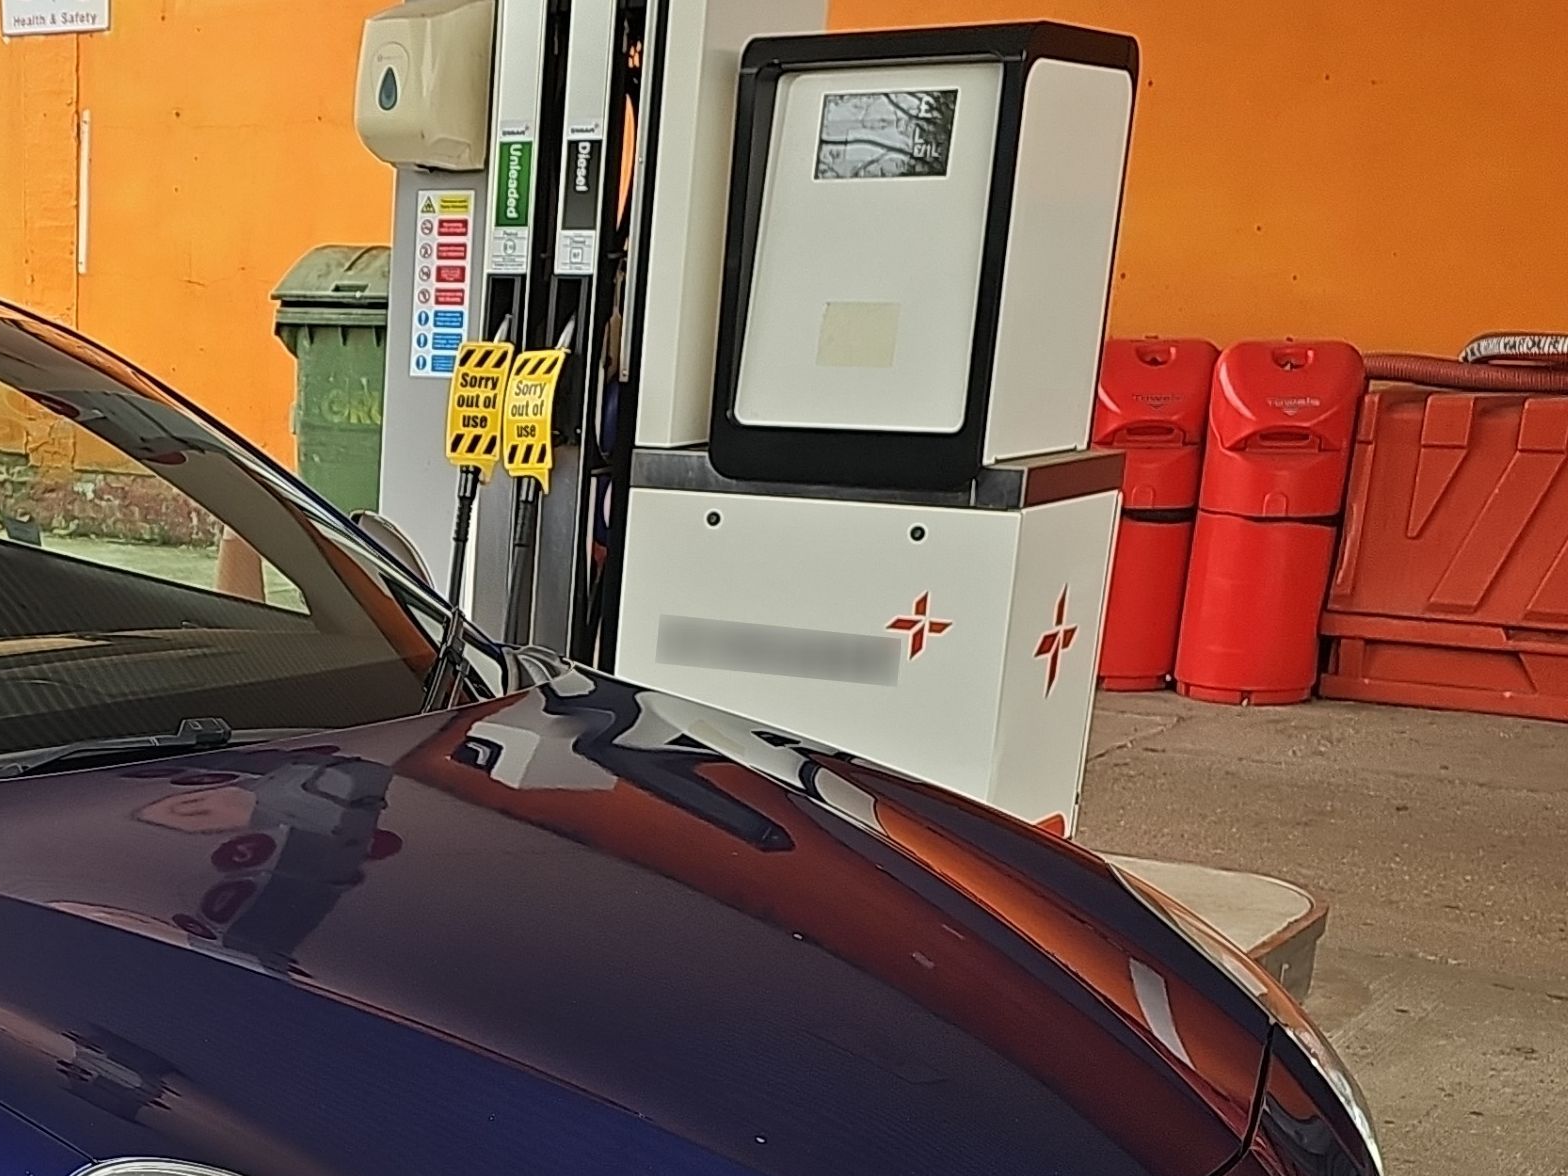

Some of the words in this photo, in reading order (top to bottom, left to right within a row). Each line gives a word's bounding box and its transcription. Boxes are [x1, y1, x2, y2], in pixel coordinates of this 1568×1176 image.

[12, 15, 46, 27] Health
[50, 13, 57, 25] &
[61, 11, 98, 26] Safety
[575, 141, 592, 192] Diesel
[506, 143, 523, 219] Unleaded
[459, 372, 500, 391] Sorry
[514, 380, 547, 399] Sorry
[456, 394, 480, 409] out
[483, 393, 498, 410] of
[511, 400, 530, 418] out
[532, 399, 544, 417] of
[462, 414, 488, 429] use
[516, 424, 537, 438] use
